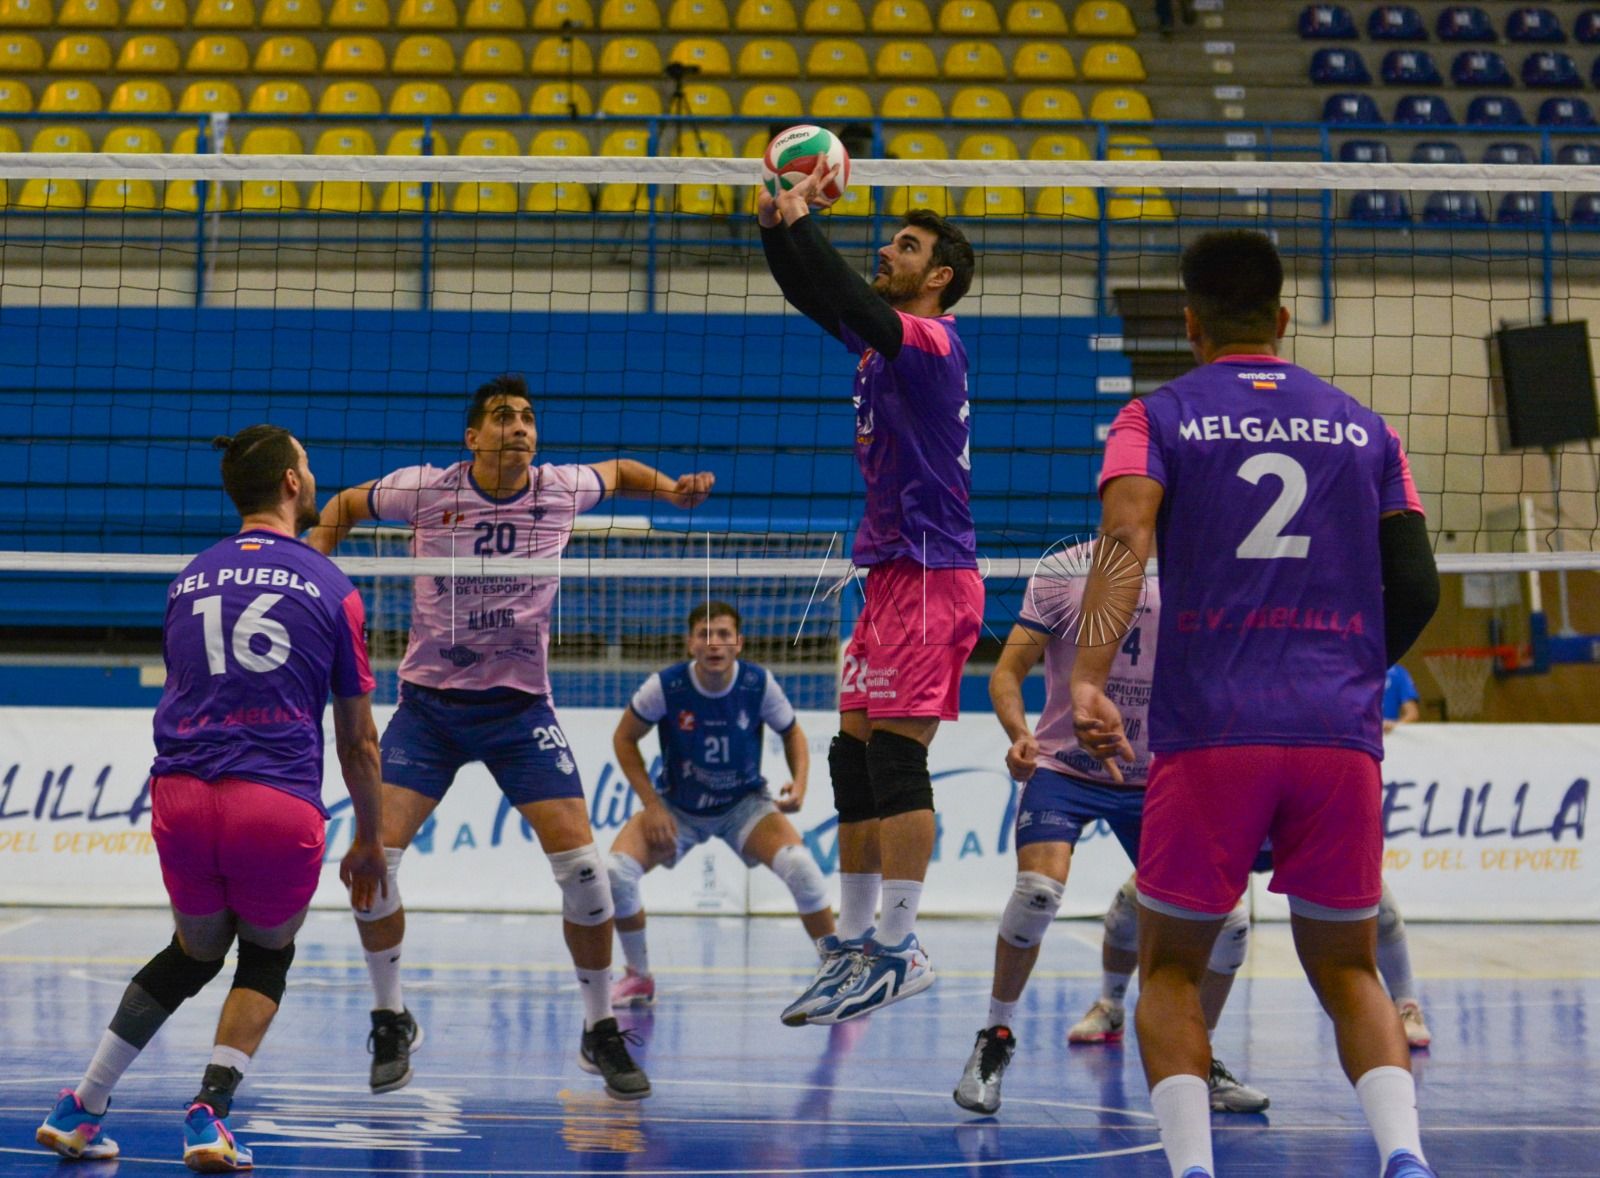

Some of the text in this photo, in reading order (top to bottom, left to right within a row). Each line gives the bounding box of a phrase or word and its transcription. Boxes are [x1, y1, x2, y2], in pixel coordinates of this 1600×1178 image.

[775, 132, 809, 147] molten
[1179, 416, 1369, 447] MELGAREJO
[1236, 452, 1311, 559] 2
[474, 521, 516, 556] 20
[217, 568, 321, 598] PUEBLO
[455, 585, 472, 596] DE
[191, 593, 292, 676] 16
[1240, 607, 1363, 638] MELILLA
[1121, 626, 1142, 667] 4
[1107, 682, 1153, 698] OMUNIT
[532, 725, 567, 750] 20
[704, 736, 730, 764] 21
[1383, 778, 1589, 842] ELILLA
[1422, 848, 1468, 870] DEL
[1480, 848, 1584, 872] DEPORTE
